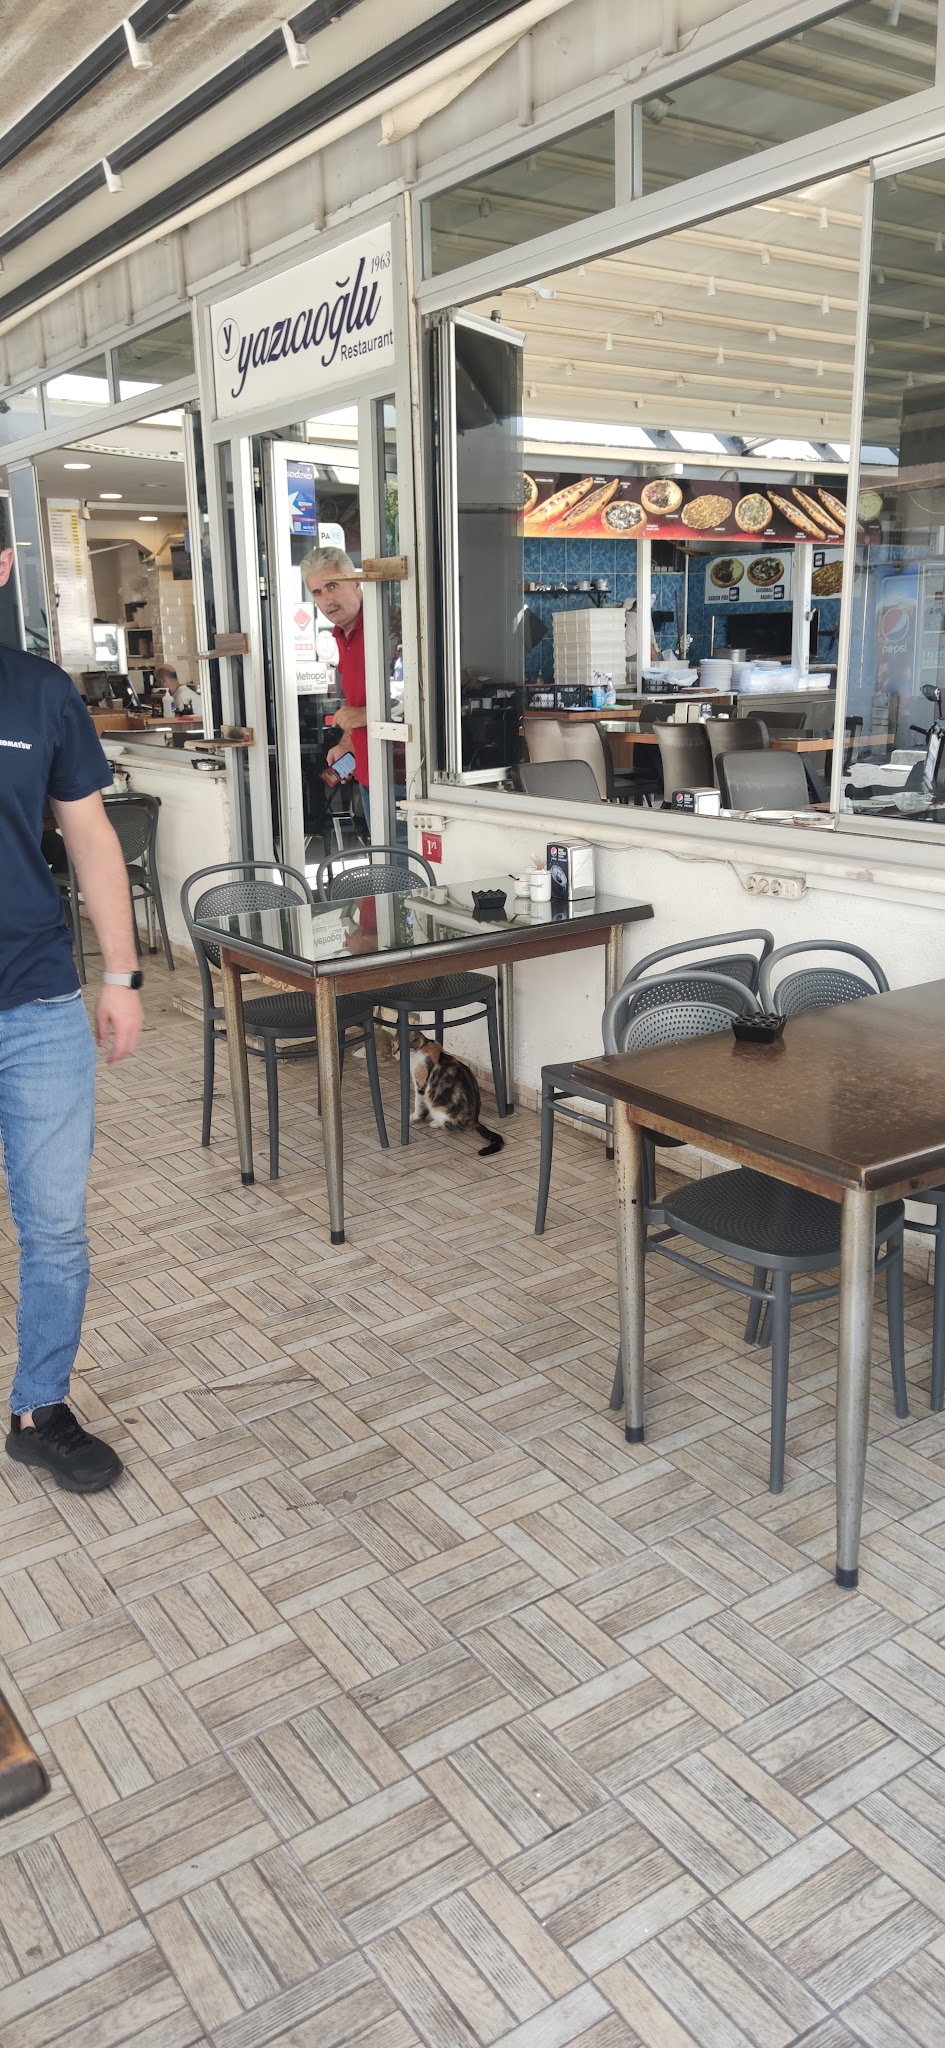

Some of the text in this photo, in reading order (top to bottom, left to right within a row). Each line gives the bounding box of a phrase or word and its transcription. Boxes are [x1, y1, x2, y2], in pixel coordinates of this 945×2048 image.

[370, 251, 391, 274] 1963
[231, 257, 382, 399] yazıcıoğlu
[340, 328, 394, 361] Restaurant
[881, 643, 907, 656] pepsi
